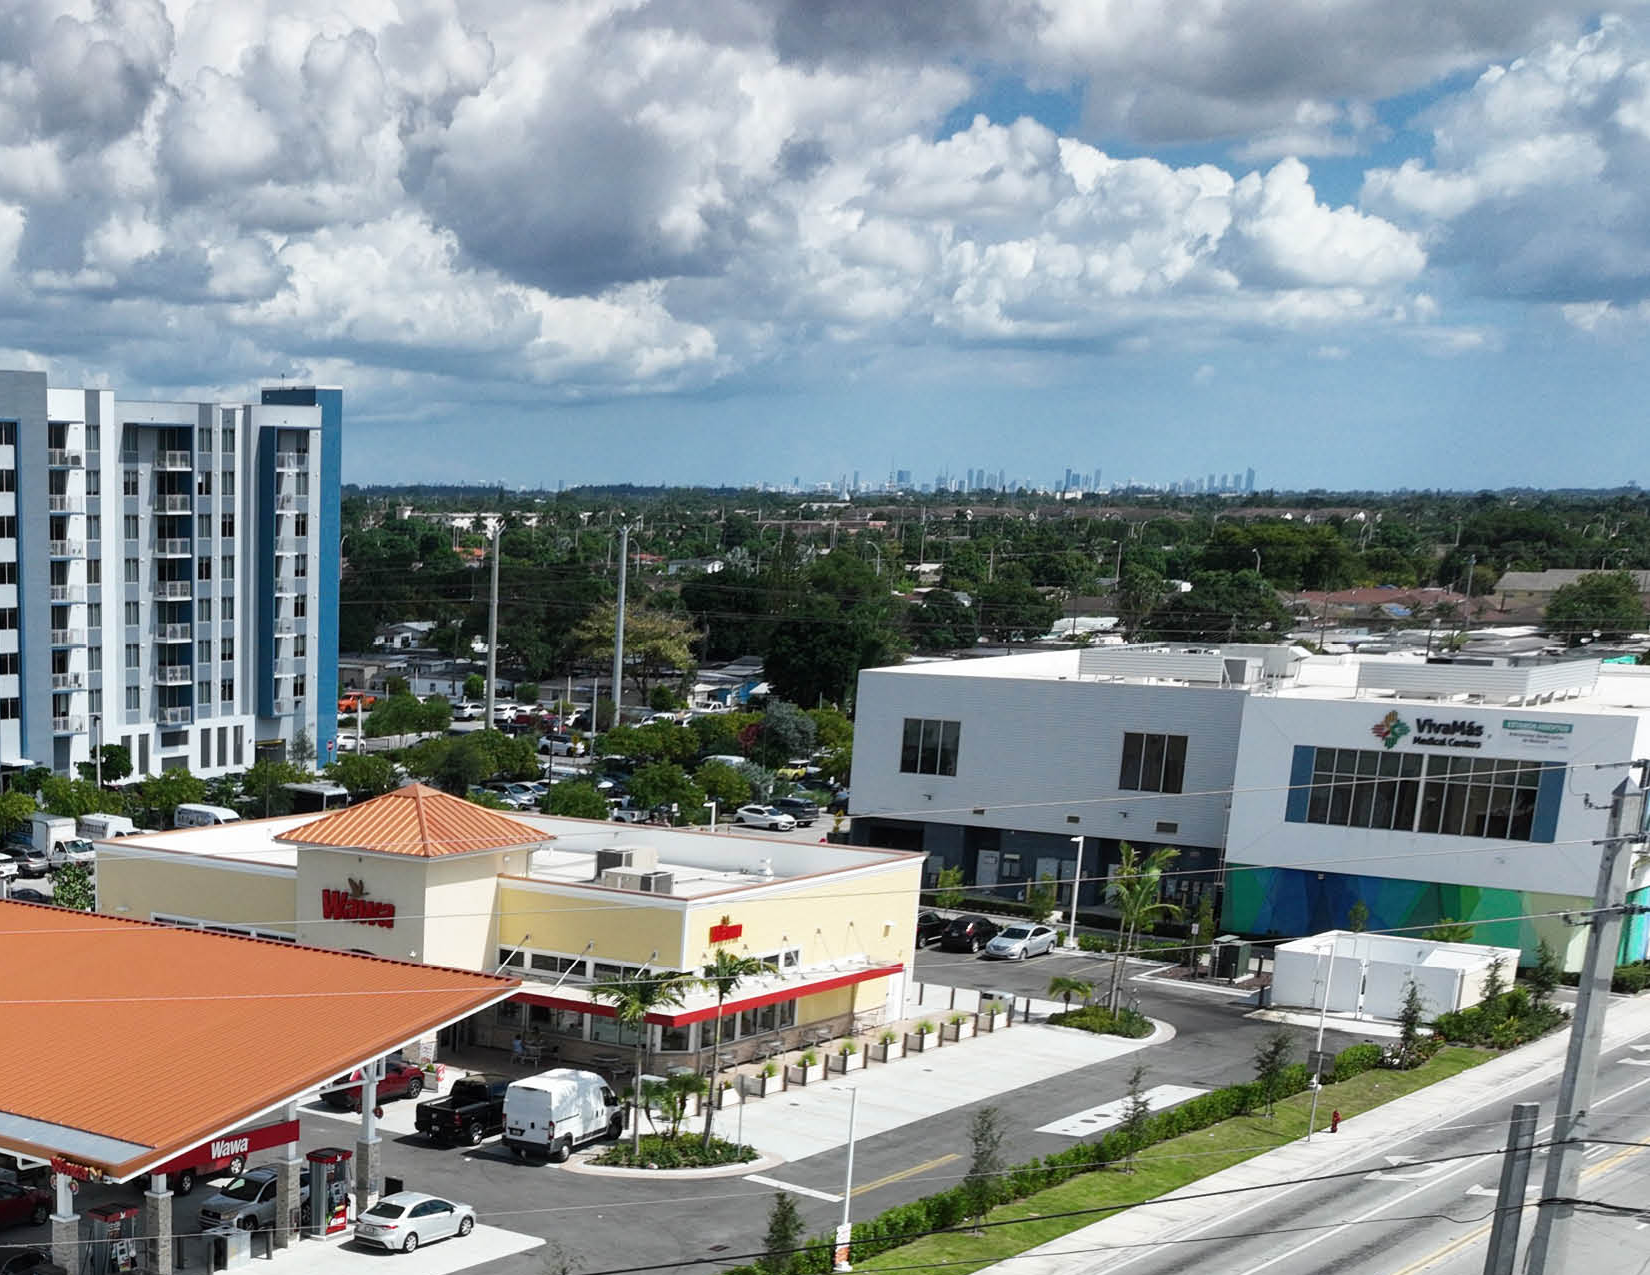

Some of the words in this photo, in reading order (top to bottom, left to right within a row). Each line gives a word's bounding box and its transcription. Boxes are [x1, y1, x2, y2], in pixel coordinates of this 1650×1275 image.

[1415, 718, 1484, 736] VivaMás
[1412, 736, 1446, 746] Medical
[321, 888, 396, 929] Wawa
[211, 1137, 249, 1160] Wawa
